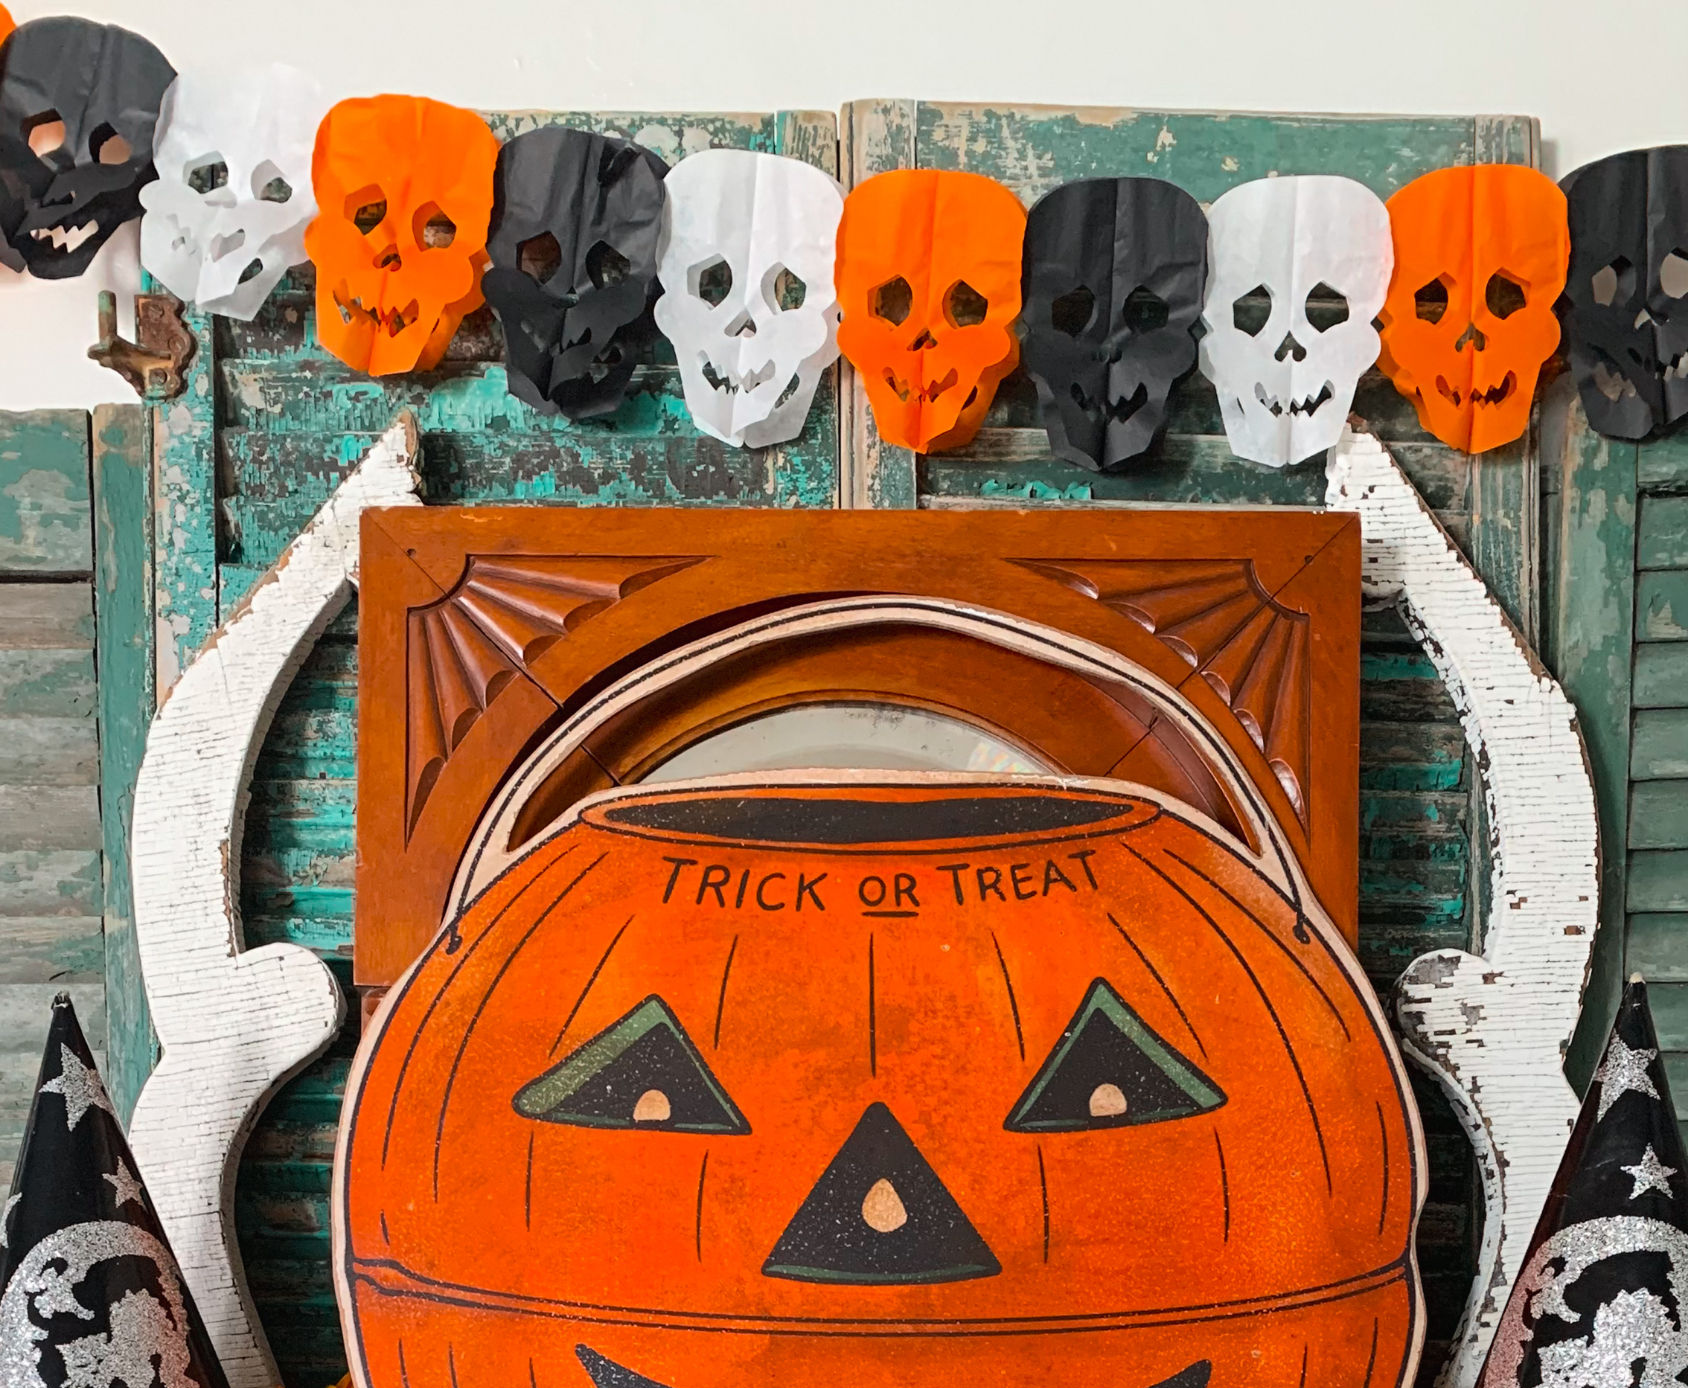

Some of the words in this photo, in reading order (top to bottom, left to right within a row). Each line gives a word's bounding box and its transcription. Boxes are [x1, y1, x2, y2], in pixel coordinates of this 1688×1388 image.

[663, 855, 828, 911] TRICK
[858, 872, 921, 908] OR
[936, 849, 1098, 906] TREAT
